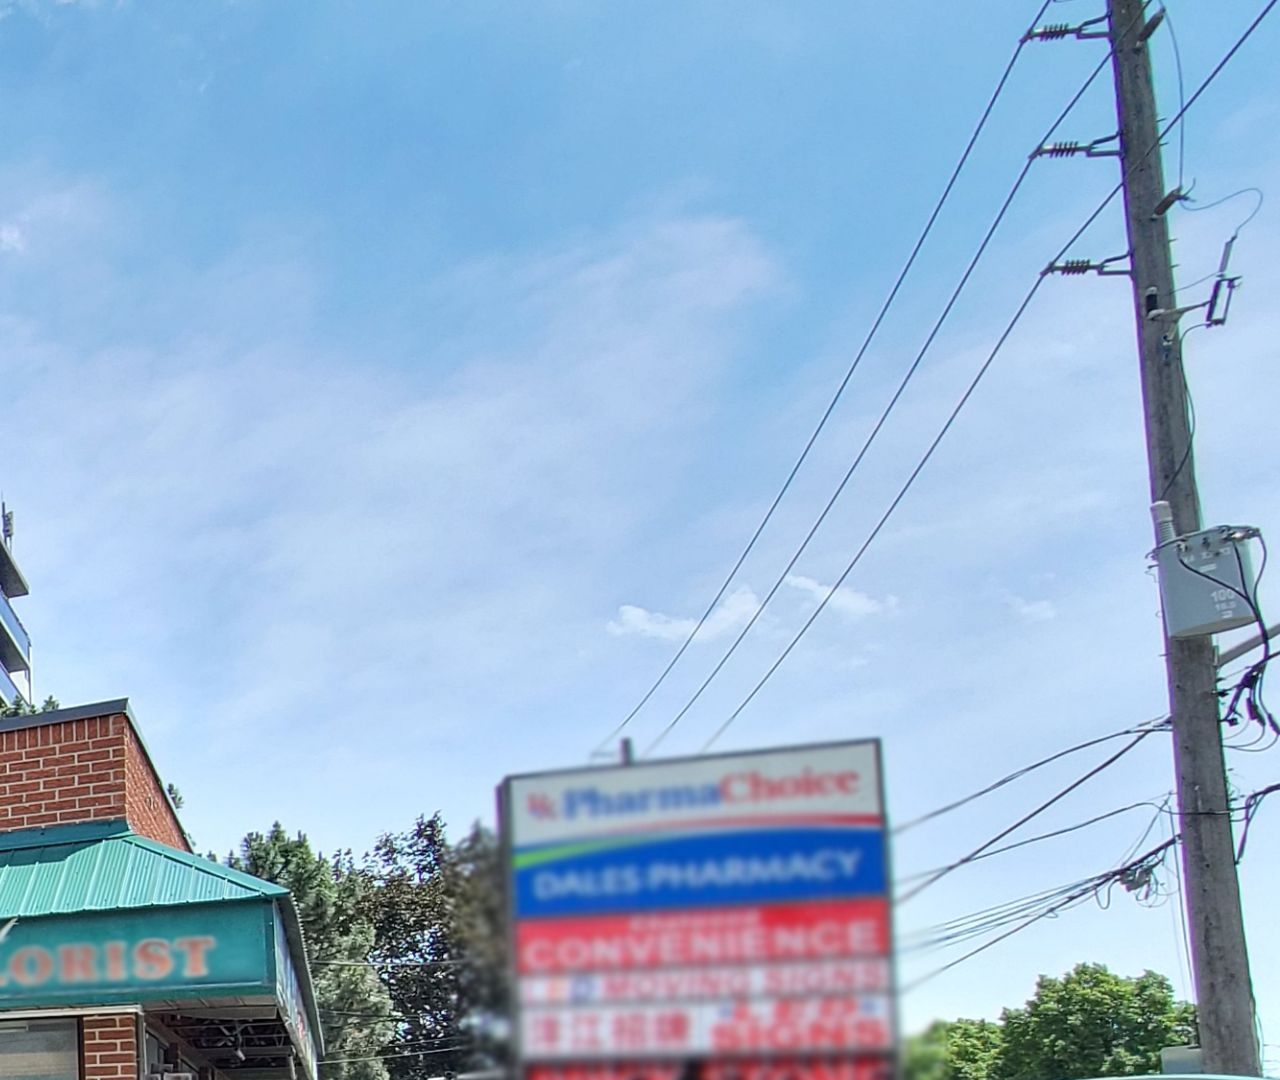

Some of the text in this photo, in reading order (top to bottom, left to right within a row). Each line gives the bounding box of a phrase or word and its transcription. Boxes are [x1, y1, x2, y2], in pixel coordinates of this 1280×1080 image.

[533, 848, 863, 900] DALES PHARMACY
[520, 919, 878, 968] CONVENIENCE
